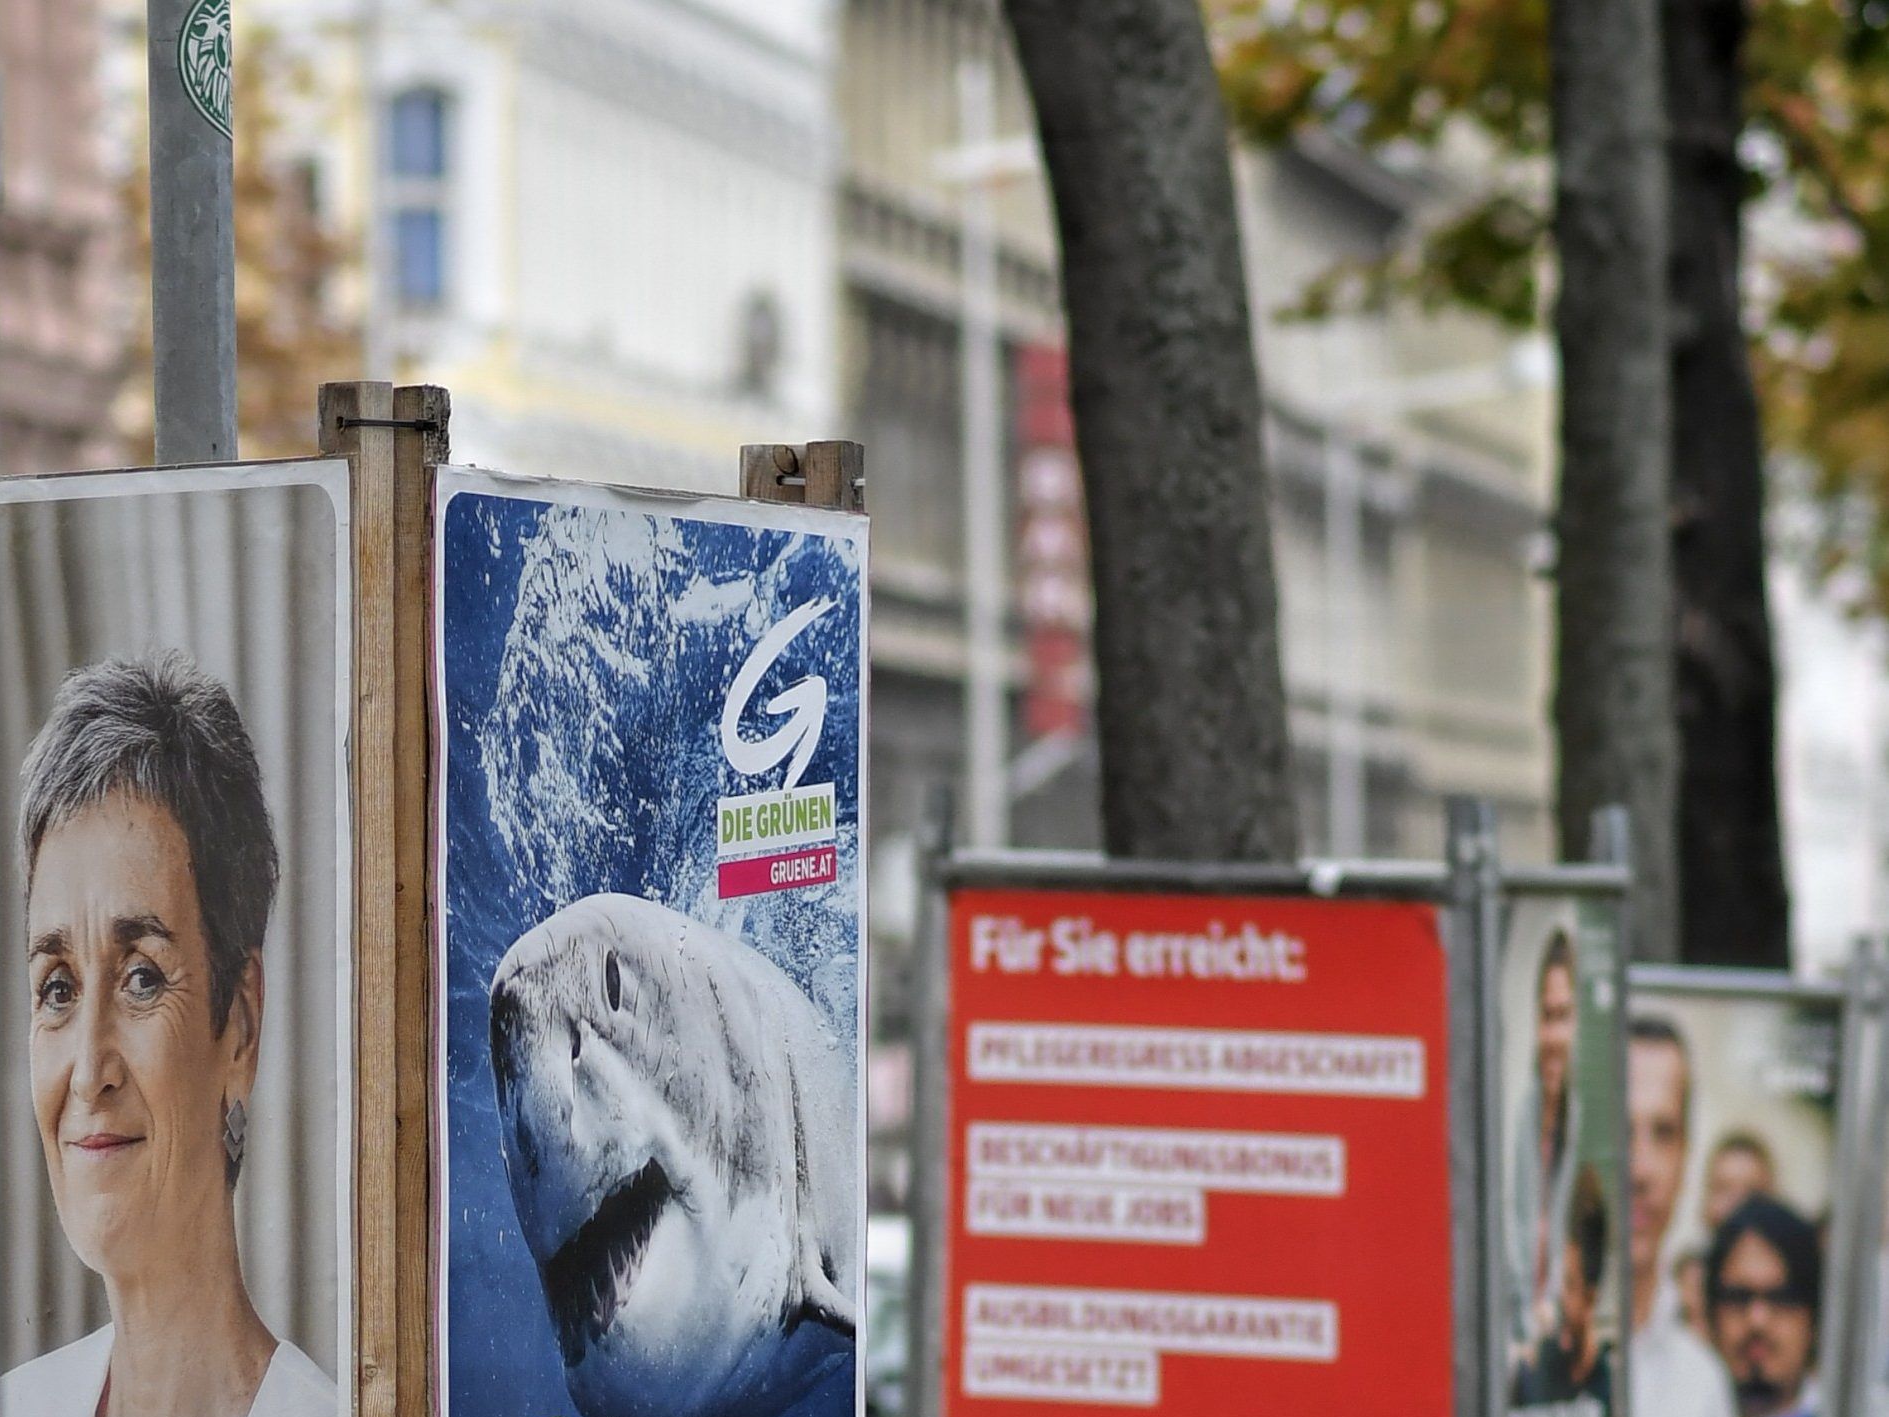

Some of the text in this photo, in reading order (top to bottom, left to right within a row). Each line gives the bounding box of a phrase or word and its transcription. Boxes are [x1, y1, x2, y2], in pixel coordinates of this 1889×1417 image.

[722, 793, 832, 844] DIE GRÜNEN
[769, 853, 833, 885] GRUENE.AT
[971, 914, 1044, 974] Für
[1050, 916, 1119, 978] Sie
